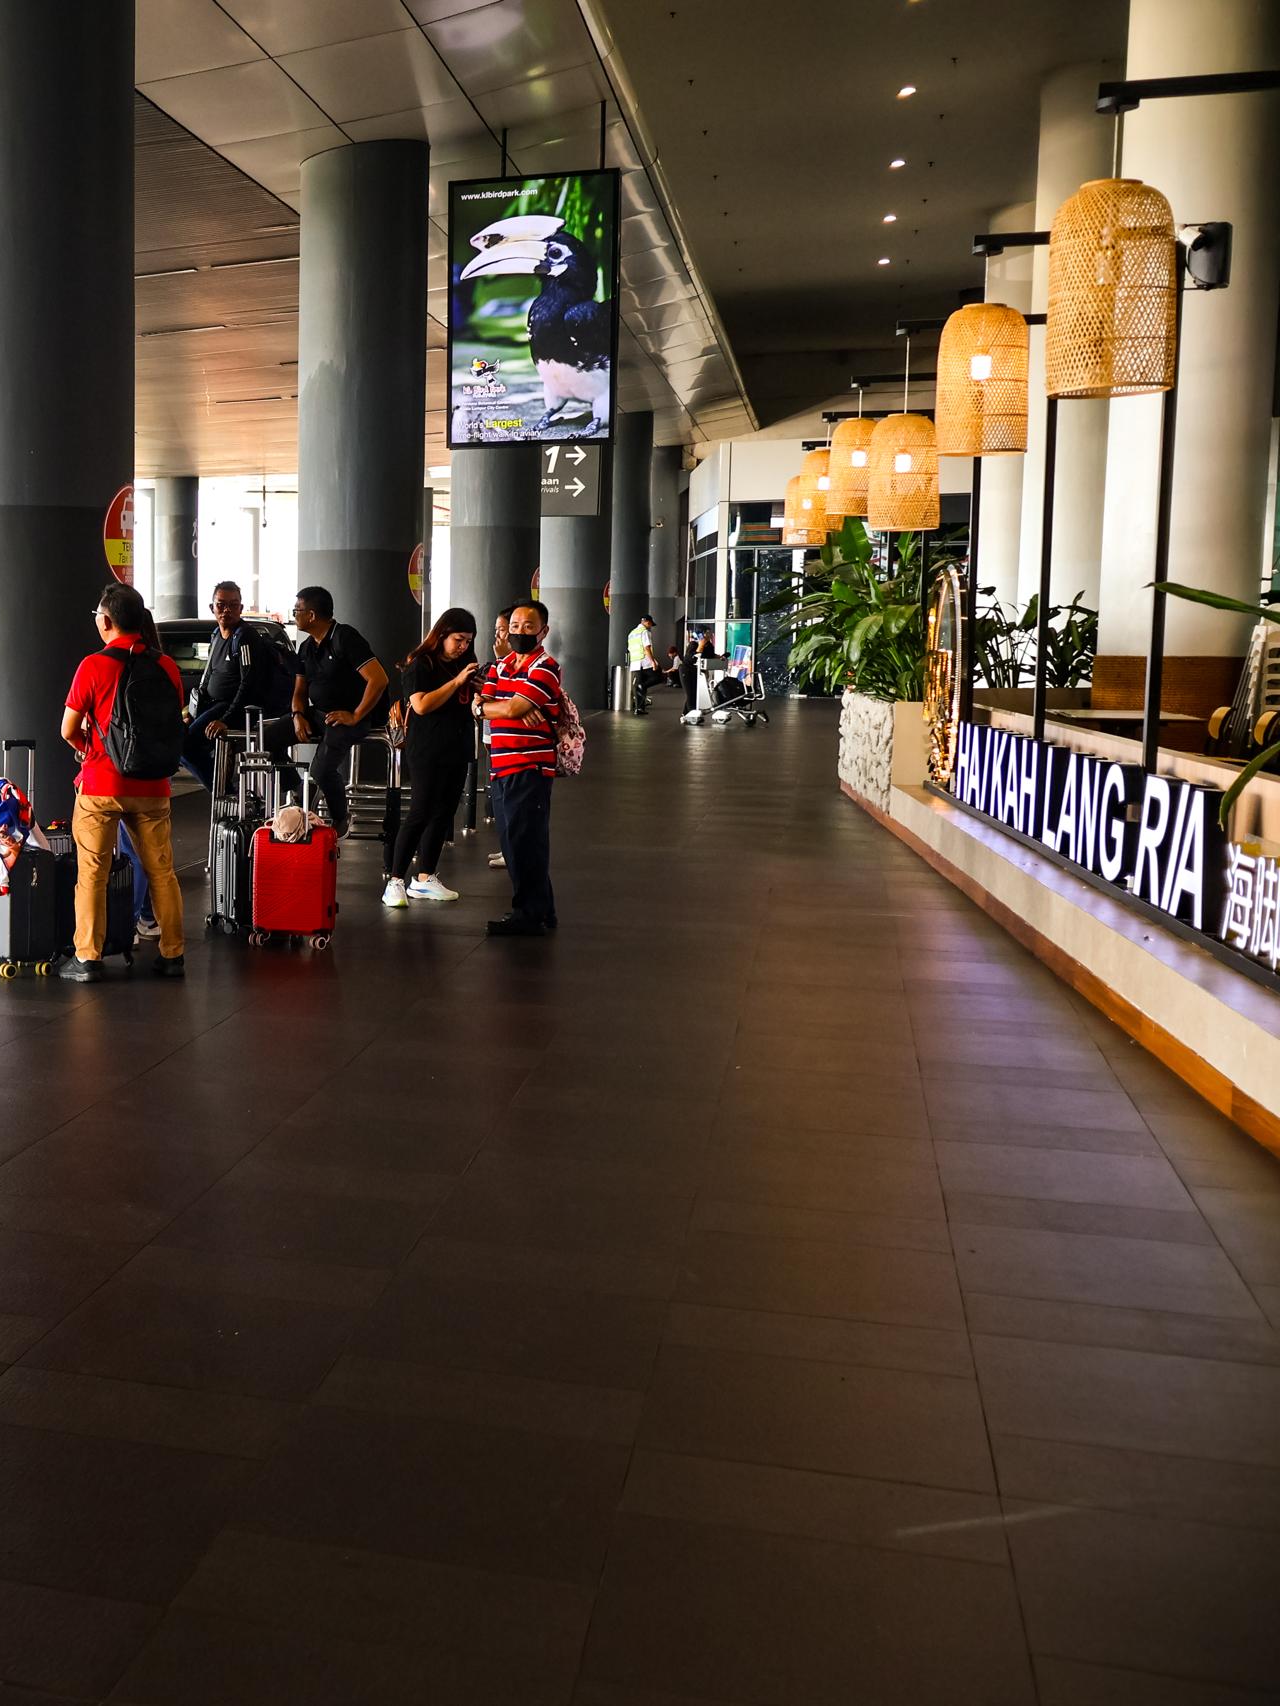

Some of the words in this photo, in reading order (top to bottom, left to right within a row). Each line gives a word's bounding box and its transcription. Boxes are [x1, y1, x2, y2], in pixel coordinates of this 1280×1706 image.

[461, 189, 538, 201] www.klbirdpark.com
[485, 418, 522, 430] Largest
[520, 430, 542, 438] aviary
[990, 731, 1038, 838] KAH
[1041, 747, 1126, 883] LANG
[1133, 773, 1206, 931] RIA
